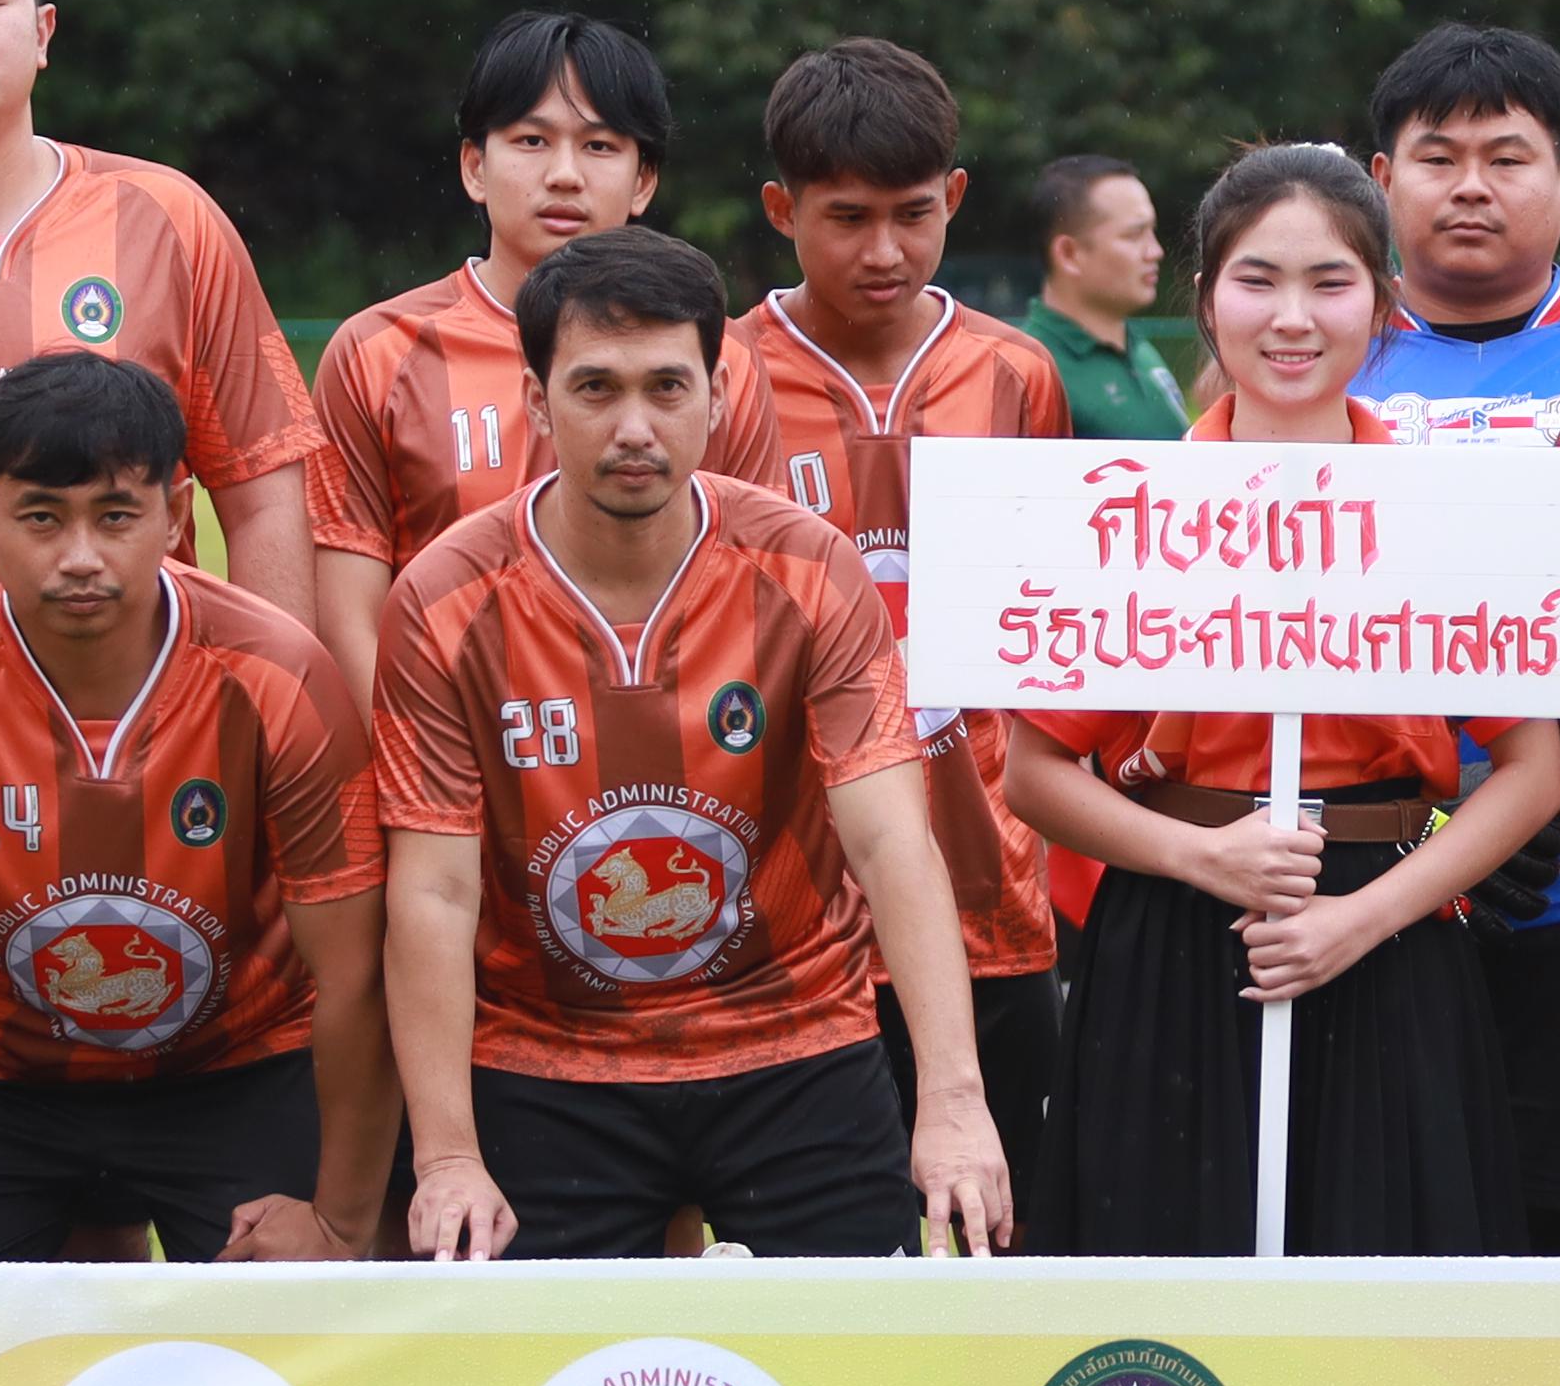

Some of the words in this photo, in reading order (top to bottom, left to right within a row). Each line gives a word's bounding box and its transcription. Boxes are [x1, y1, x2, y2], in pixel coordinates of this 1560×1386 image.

[451, 405, 502, 472] 11
[1083, 457, 1381, 576] ศิษย์เก่า
[500, 697, 581, 769] 28
[528, 810, 584, 877] PUBLIC
[588, 784, 760, 844] ADMINISTRATION
[46, 872, 226, 940] ADMINISTRATION
